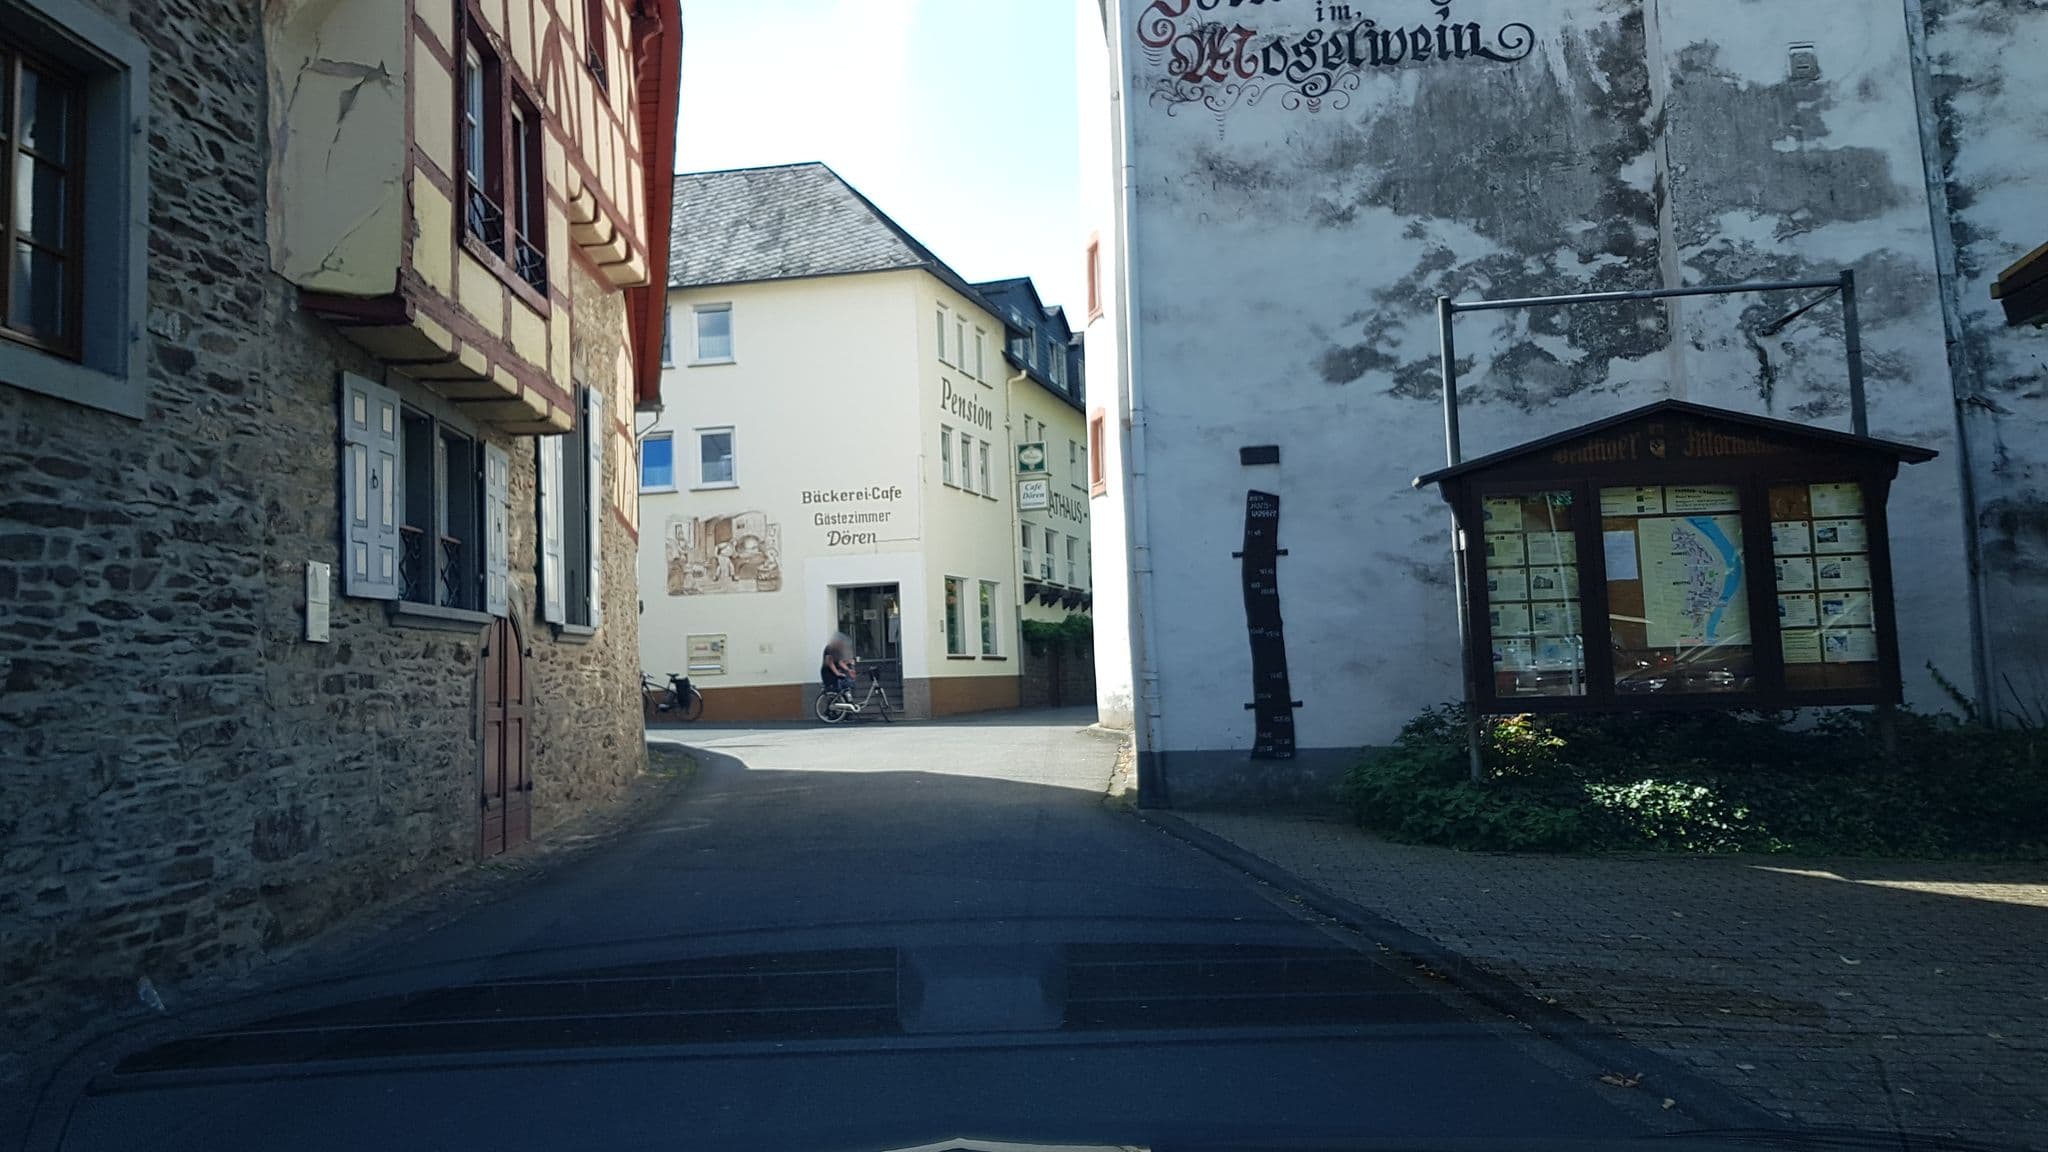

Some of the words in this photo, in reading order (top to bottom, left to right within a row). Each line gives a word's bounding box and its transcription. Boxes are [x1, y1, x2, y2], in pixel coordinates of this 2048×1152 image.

[1168, 8, 1534, 97] Moselwein
[941, 376, 992, 431] Pension
[814, 511, 891, 526] Gästezimmer
[827, 530, 876, 546] Dören
